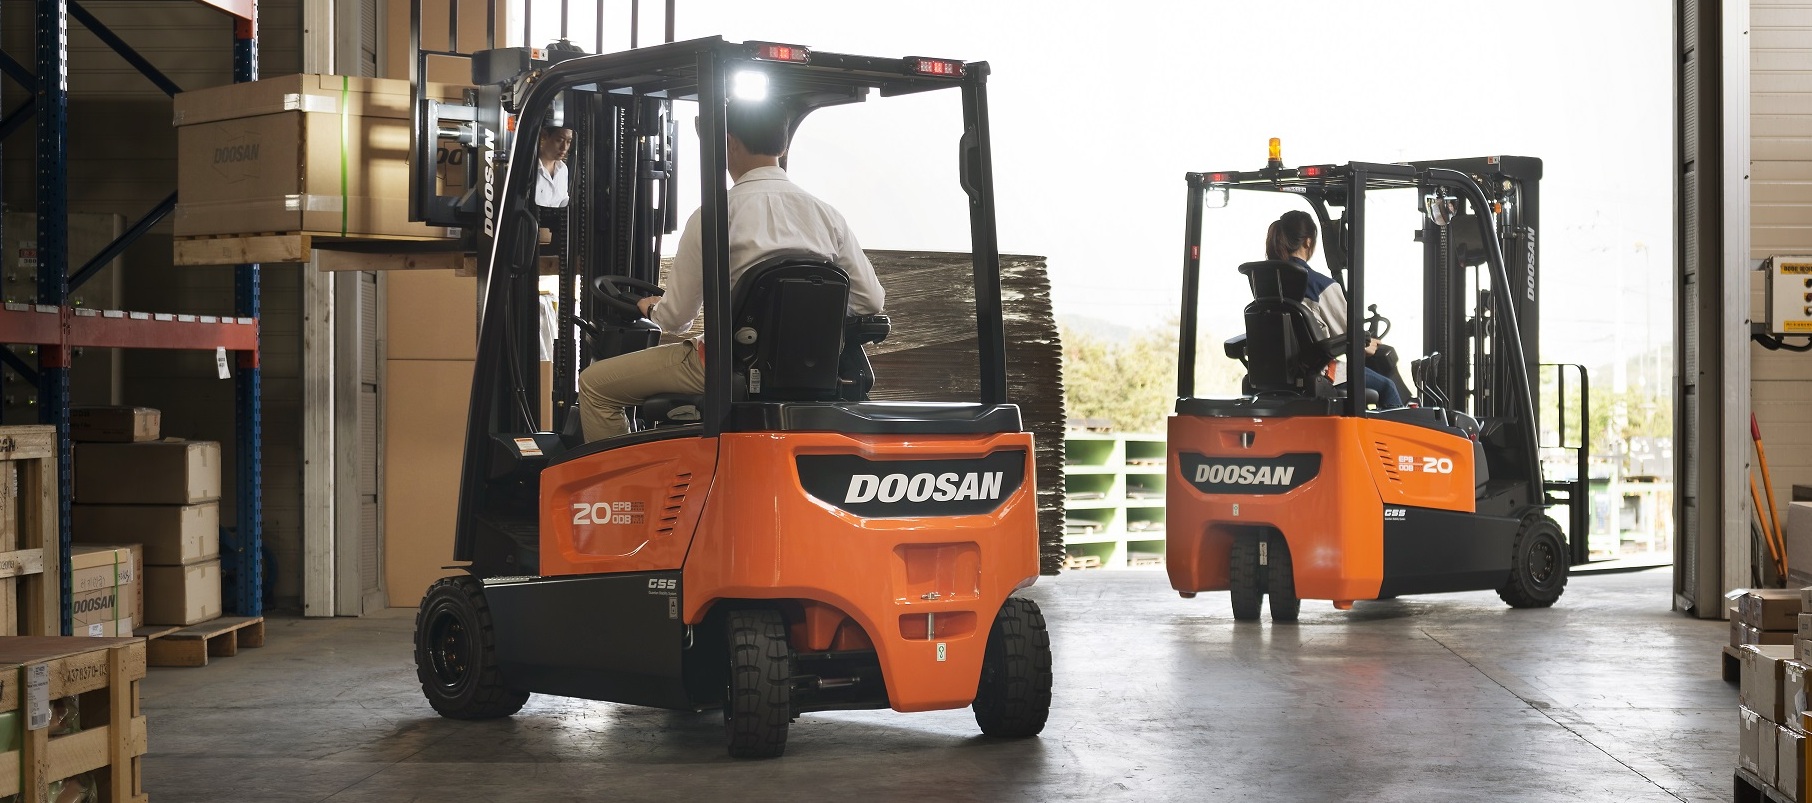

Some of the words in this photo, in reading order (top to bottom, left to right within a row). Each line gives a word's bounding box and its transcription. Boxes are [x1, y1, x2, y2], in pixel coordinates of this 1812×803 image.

[214, 144, 260, 165] DOOSAN
[484, 128, 495, 238] DOOSAN
[1527, 226, 1536, 302] DOOSAN
[1195, 464, 1295, 486] DOOSAN
[1423, 456, 1453, 475] 20
[844, 471, 1004, 504] DOOSAN
[573, 502, 612, 525] 20
[612, 502, 632, 511] EPB
[1384, 509, 1406, 517] GSS
[648, 578, 677, 590] GSS
[74, 595, 115, 614] DOOSAN
